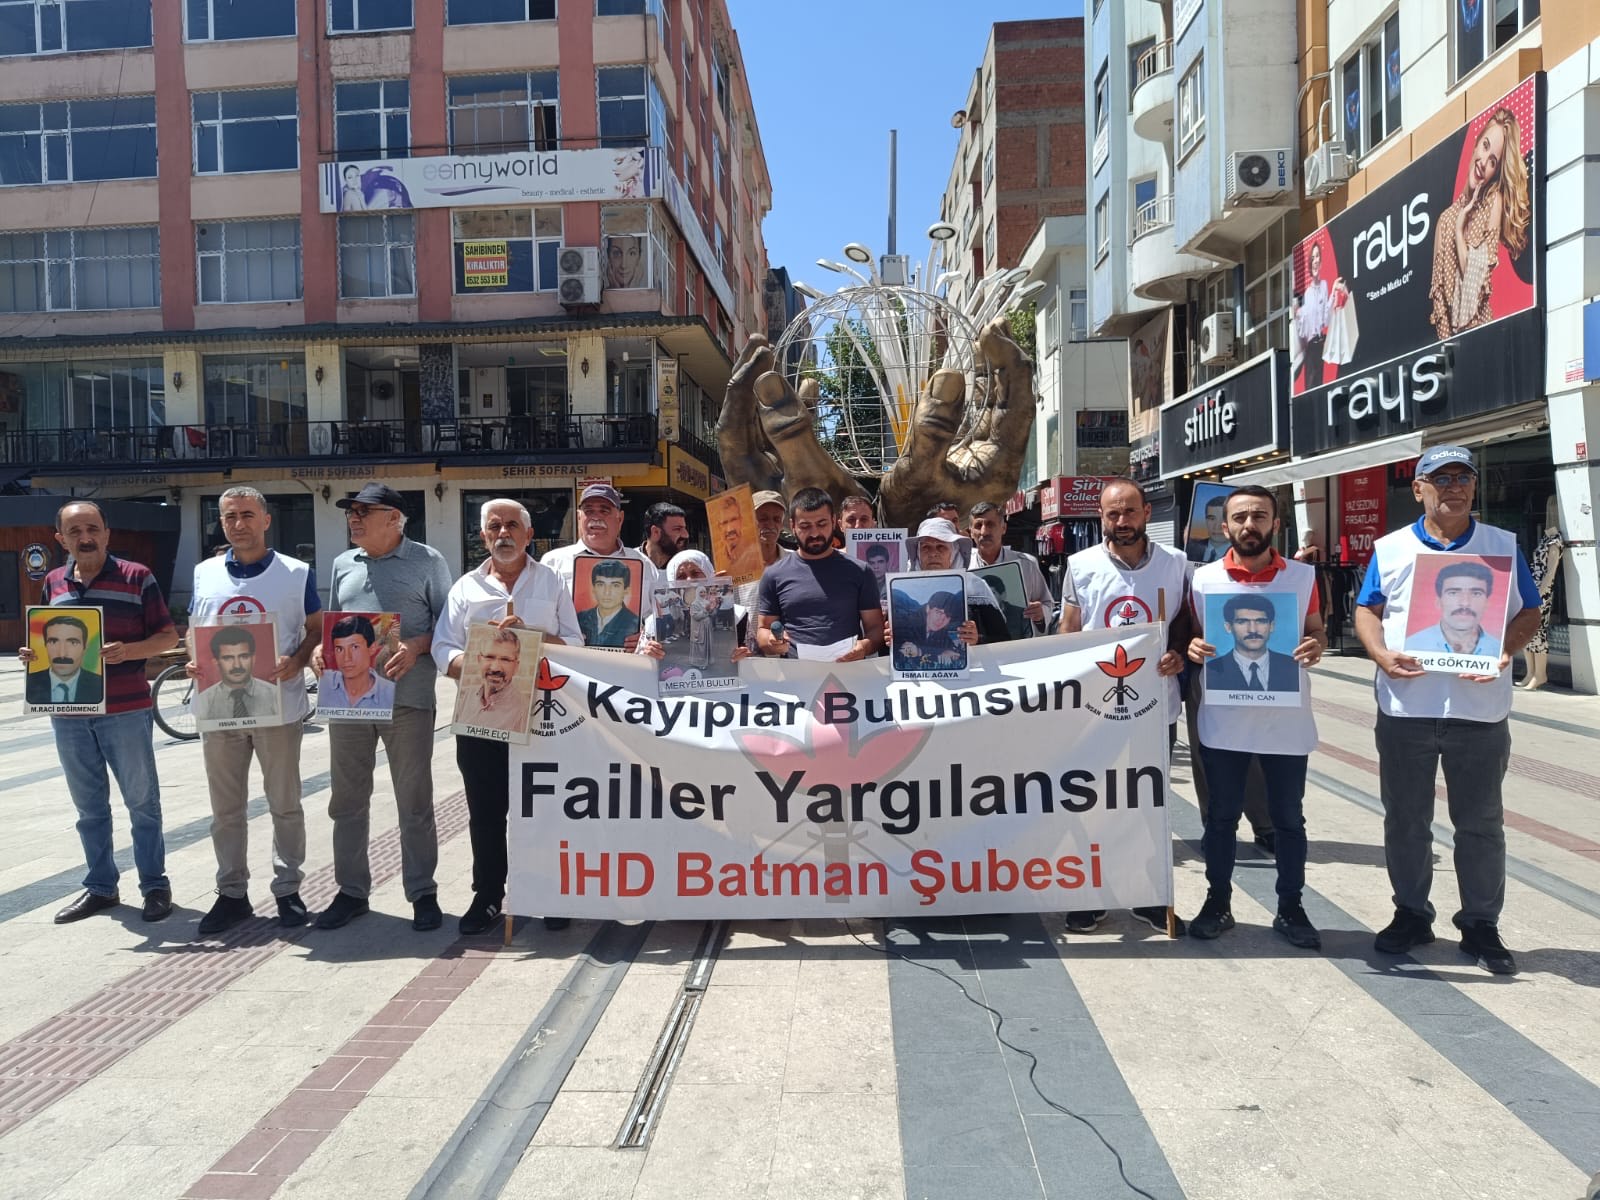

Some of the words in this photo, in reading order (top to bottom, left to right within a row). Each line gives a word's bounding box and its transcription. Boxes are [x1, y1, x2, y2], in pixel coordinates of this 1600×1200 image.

[1277, 151, 1286, 187] BEKO
[521, 189, 543, 198] beauty
[549, 187, 575, 196] medical
[580, 186, 606, 195] esthetic
[1353, 192, 1430, 279] rays
[1326, 354, 1441, 426] rays
[1184, 389, 1236, 446] stilife
[1430, 450, 1470, 461] adidas
[327, 466, 375, 477] SOFRASI
[538, 465, 588, 476] SOFRASI
[851, 532, 873, 541] EDİP
[875, 531, 902, 542] ÇELİK
[1437, 656, 1490, 671] GÖKTAYI
[902, 671, 929, 679] İSMAİL
[665, 680, 703, 691] MERYEM
[706, 678, 736, 689] BULUT
[1228, 692, 1254, 701] METİN
[1256, 693, 1275, 702] CAN
[587, 681, 806, 737] Kayıplar
[824, 678, 1082, 724] Bulunsun
[1104, 712, 1132, 721] HAKLARI
[466, 725, 491, 737] TAHİR
[491, 730, 510, 741] ELÇİ
[521, 762, 737, 822] Failler
[754, 763, 1165, 835] Yargılansın
[560, 840, 656, 897] İHD
[677, 852, 889, 897] Batman
[909, 843, 1103, 906] Şubesi
